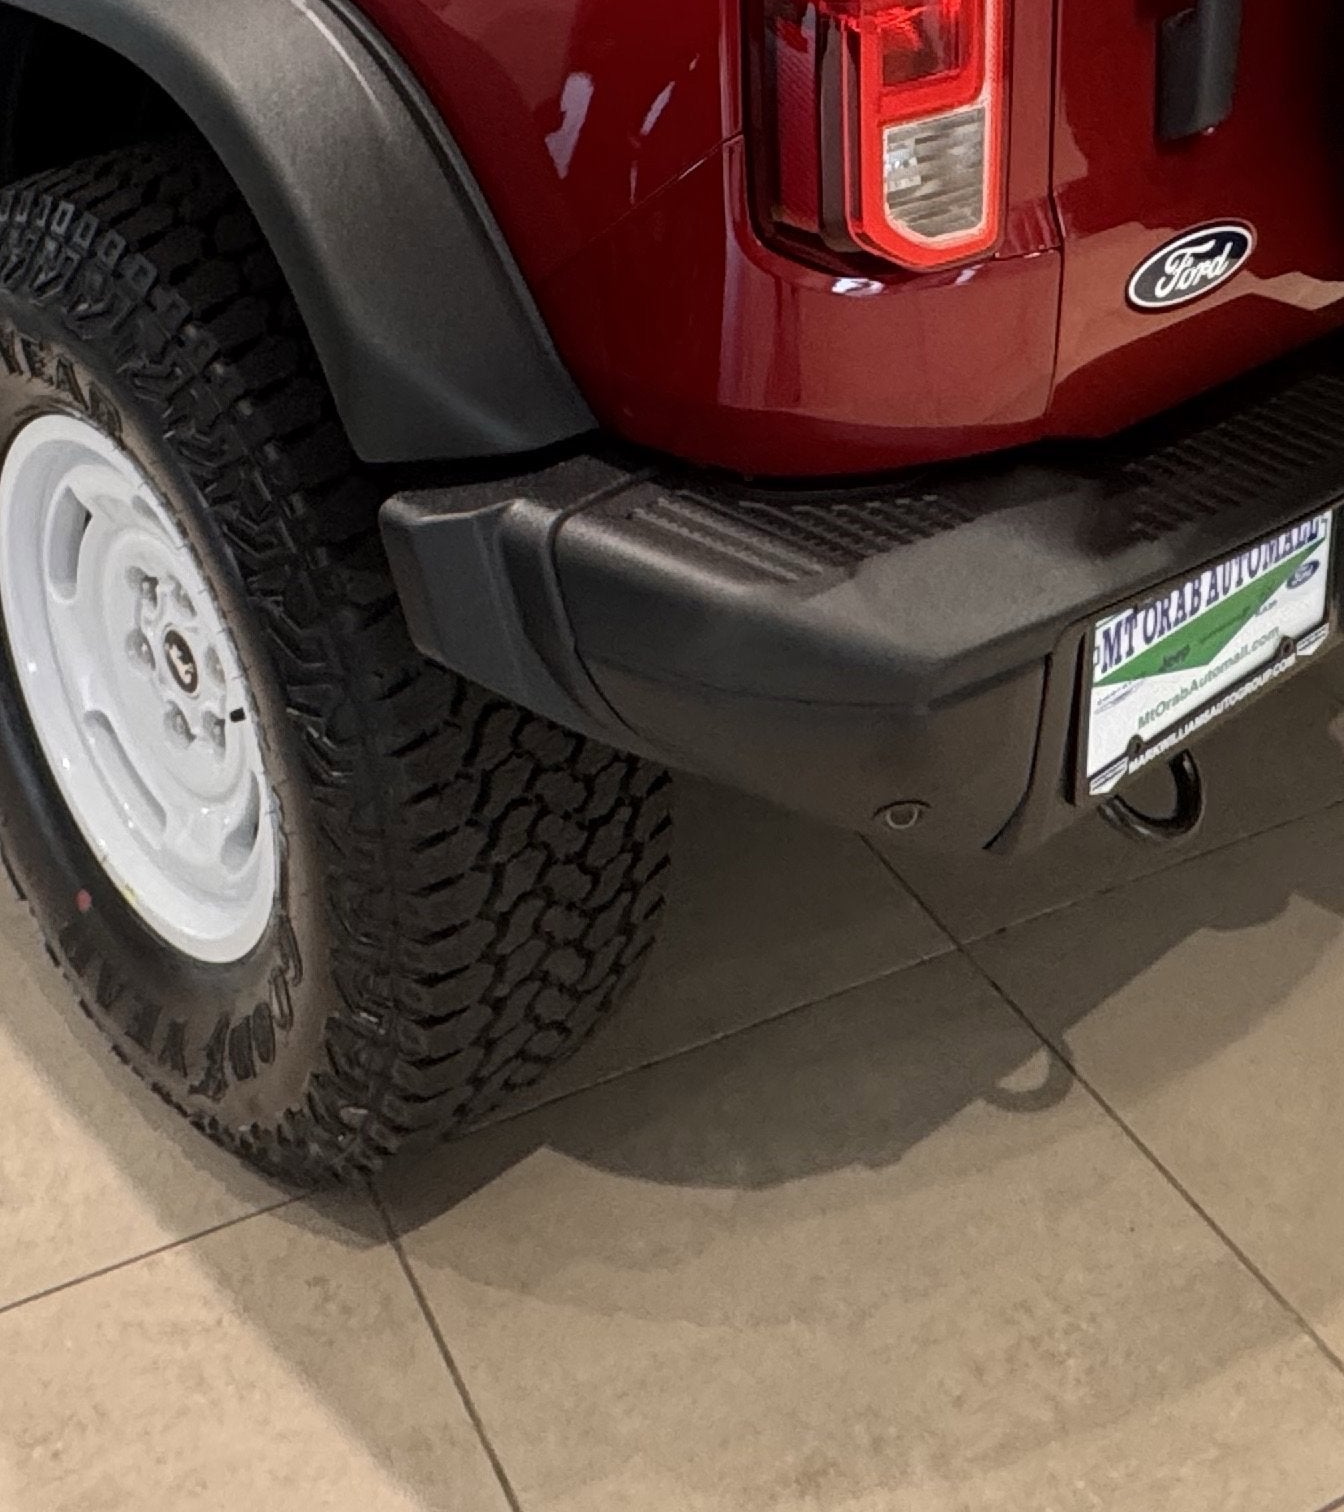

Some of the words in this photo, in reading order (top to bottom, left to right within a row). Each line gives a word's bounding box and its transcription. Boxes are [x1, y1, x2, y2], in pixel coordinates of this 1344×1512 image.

[1153, 238, 1235, 299] Ford
[1100, 604, 1139, 674] MT
[1142, 575, 1203, 645] ORAB
[1137, 626, 1280, 729] MtOrabAutomall.com
